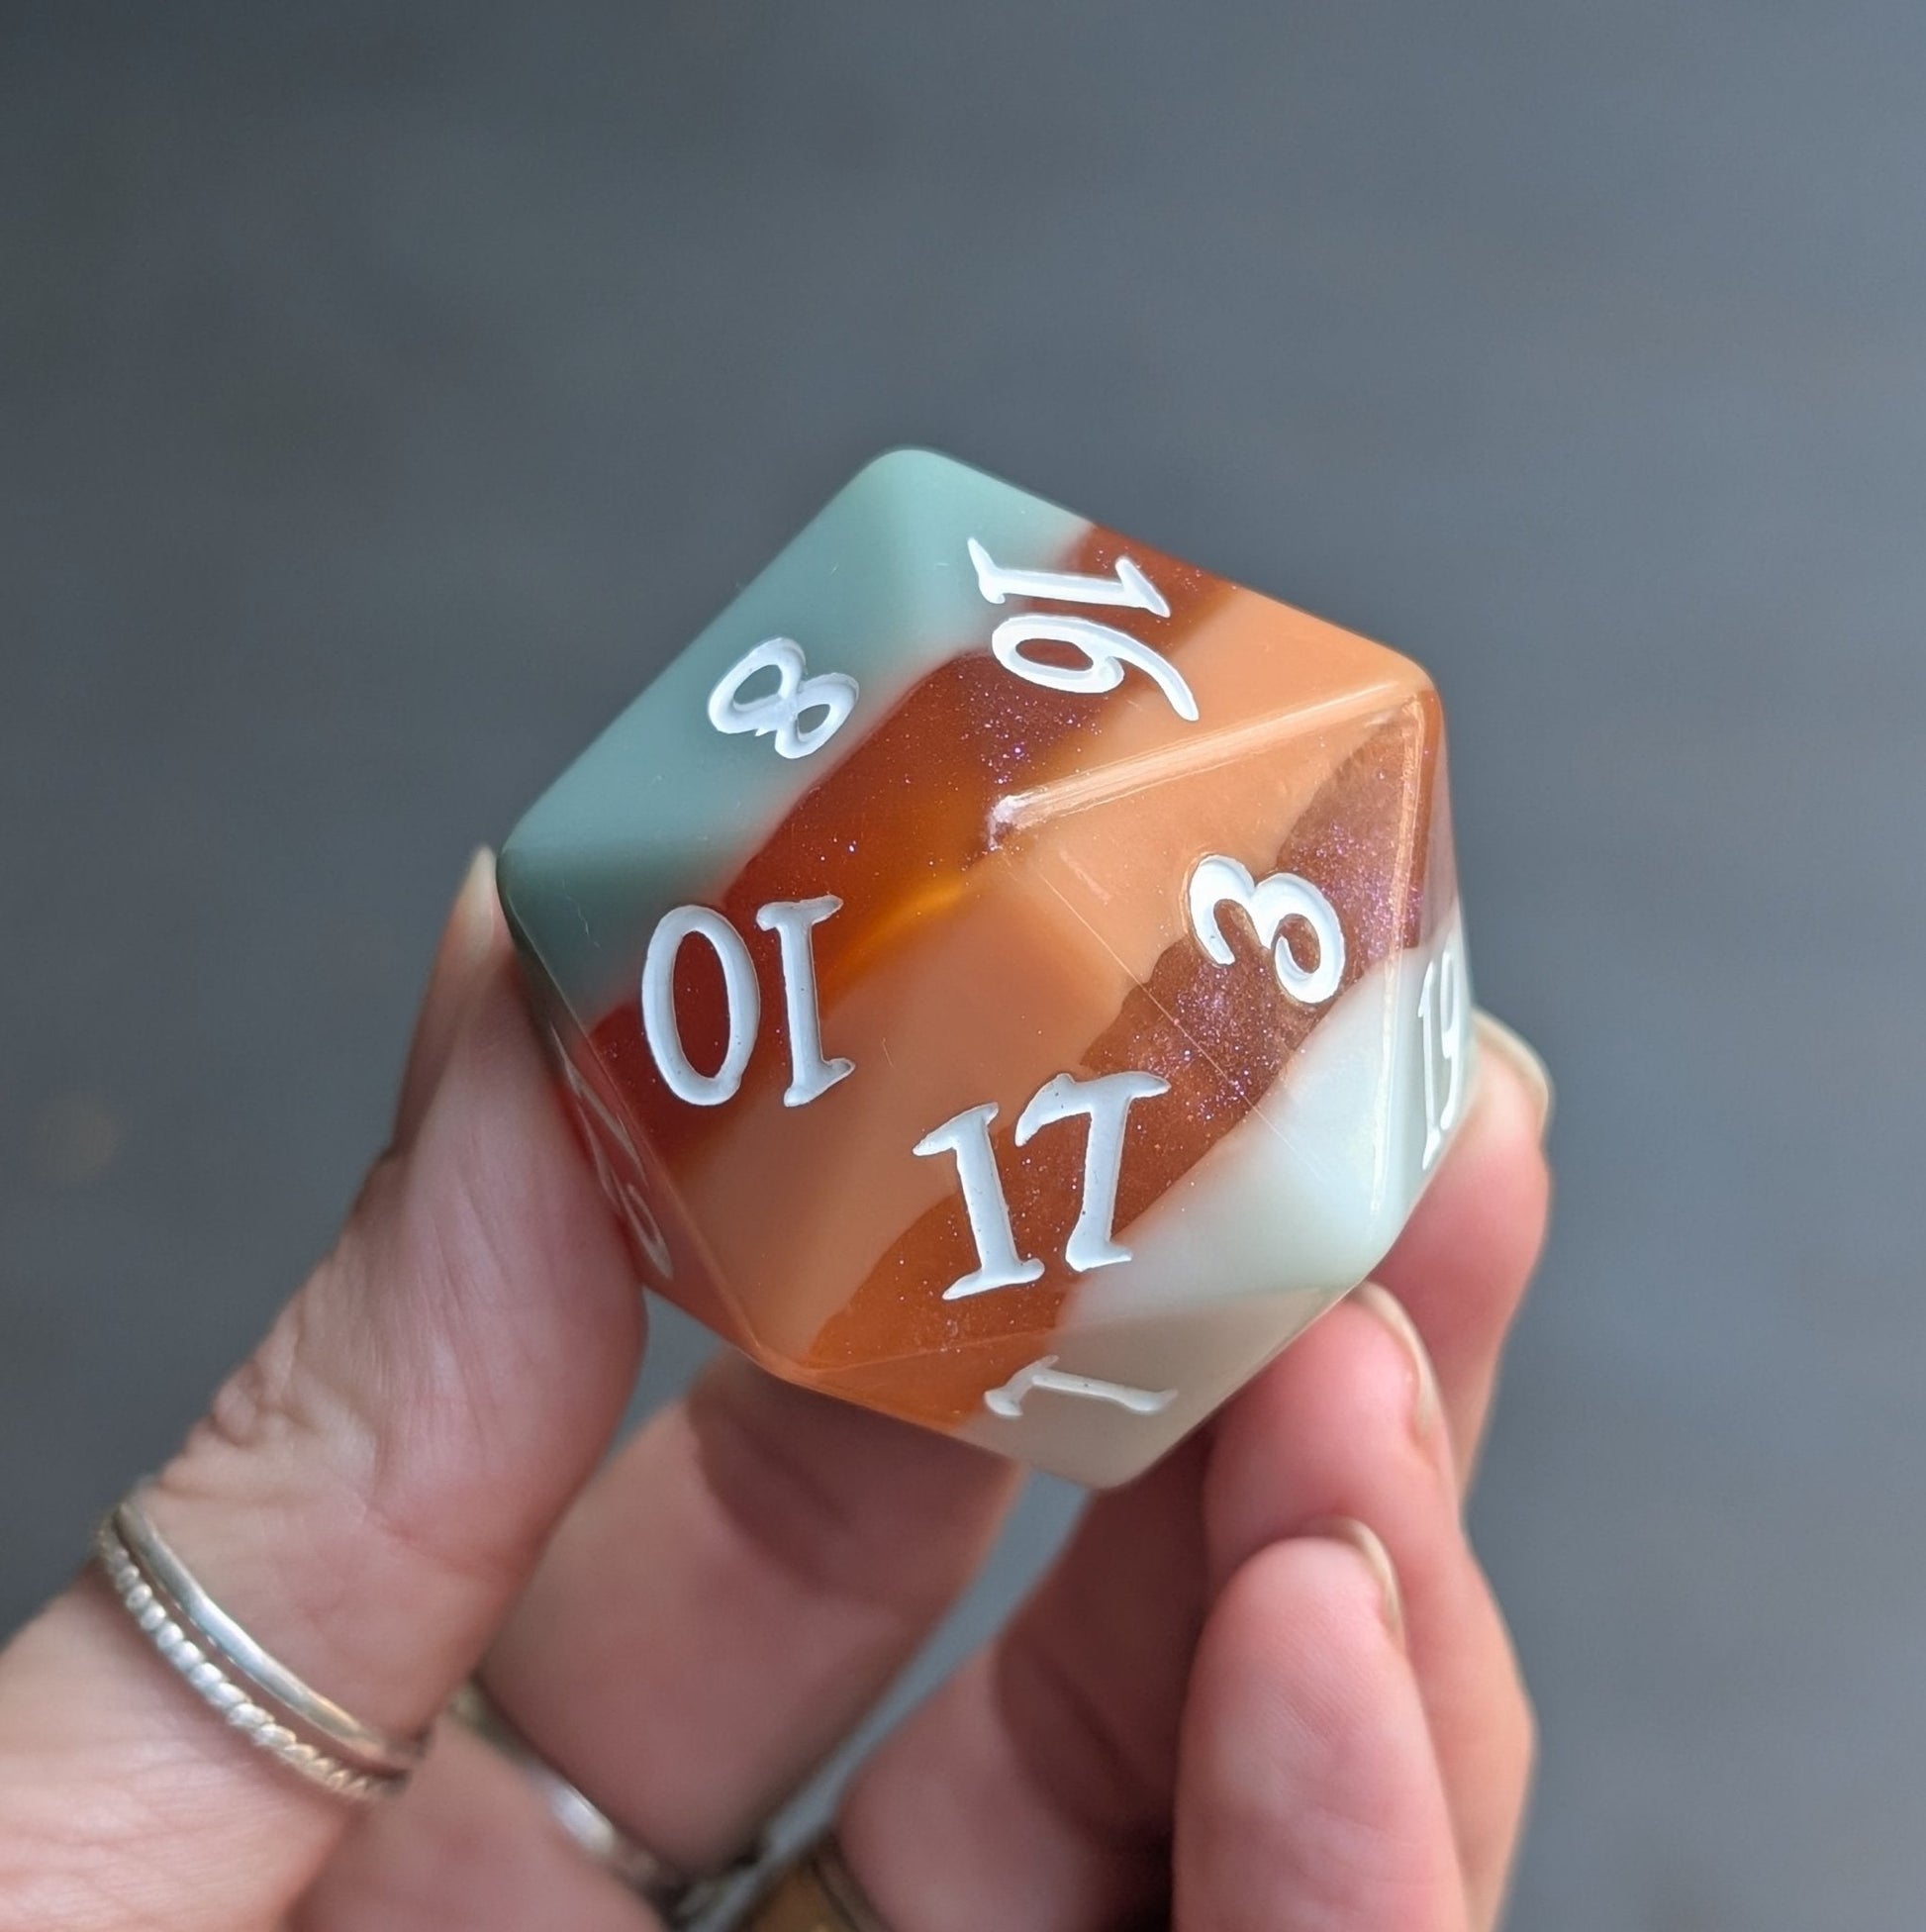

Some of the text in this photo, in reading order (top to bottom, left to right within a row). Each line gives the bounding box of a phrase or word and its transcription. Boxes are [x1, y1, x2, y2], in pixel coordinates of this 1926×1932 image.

[708, 636, 859, 760] 8
[967, 537, 1200, 721] 16
[642, 895, 855, 1108] 10
[1189, 854, 1346, 1006] 3
[913, 1071, 1172, 1301] 17
